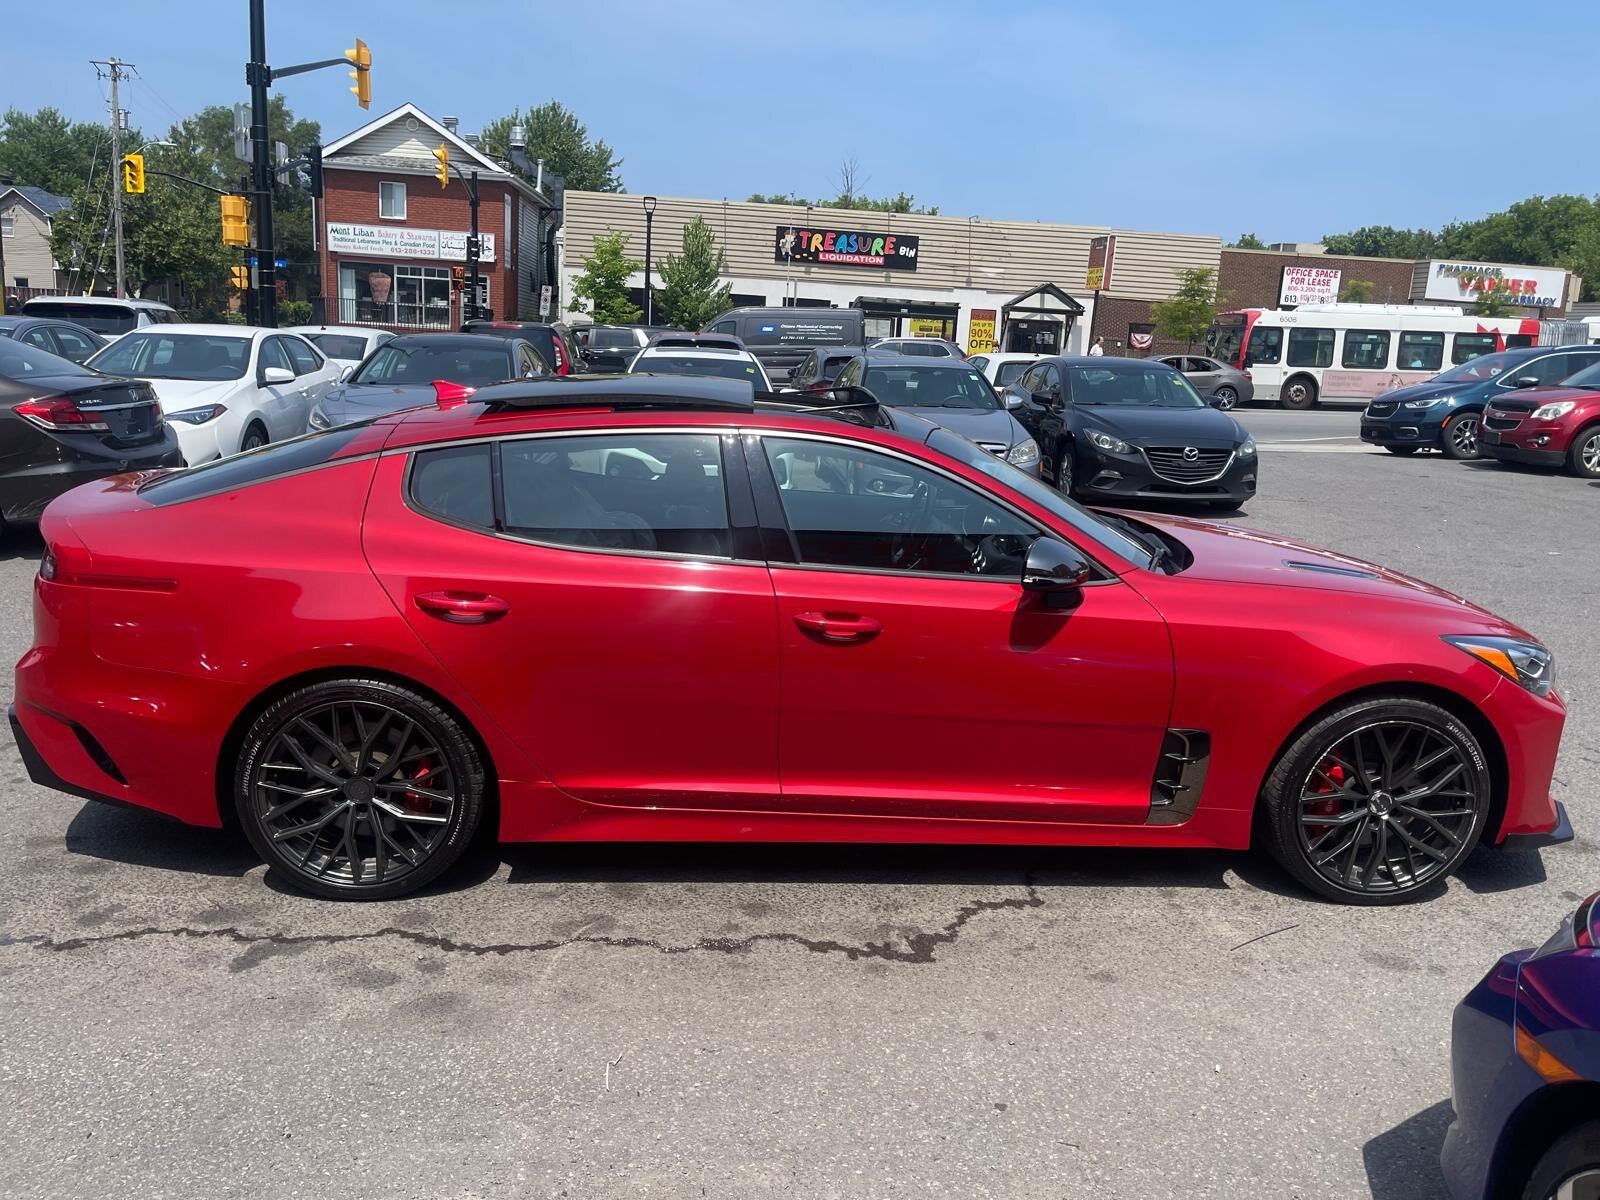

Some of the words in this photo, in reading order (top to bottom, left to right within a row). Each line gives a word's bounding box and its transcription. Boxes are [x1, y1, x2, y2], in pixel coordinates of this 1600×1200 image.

[330, 225, 350, 235] Mont
[353, 227, 375, 238] Liban
[377, 230, 397, 240] Bakery
[399, 231, 405, 240] &
[406, 232, 436, 242] Shawarma
[799, 231, 897, 256] TREASURE
[899, 246, 917, 258] BIN
[820, 253, 884, 264] LIQUIDATION
[1286, 268, 1313, 278] OFFICE
[1315, 269, 1339, 279] SPACE
[1437, 264, 1502, 277] PHARMACIE
[1290, 277, 1305, 286] FOR
[1307, 278, 1332, 287] LEASE
[1284, 295, 1297, 303] 613
[971, 328, 993, 339] 90%
[970, 339, 993, 349] OFF
[1446, 722, 1484, 771] BRIDGESTONE
